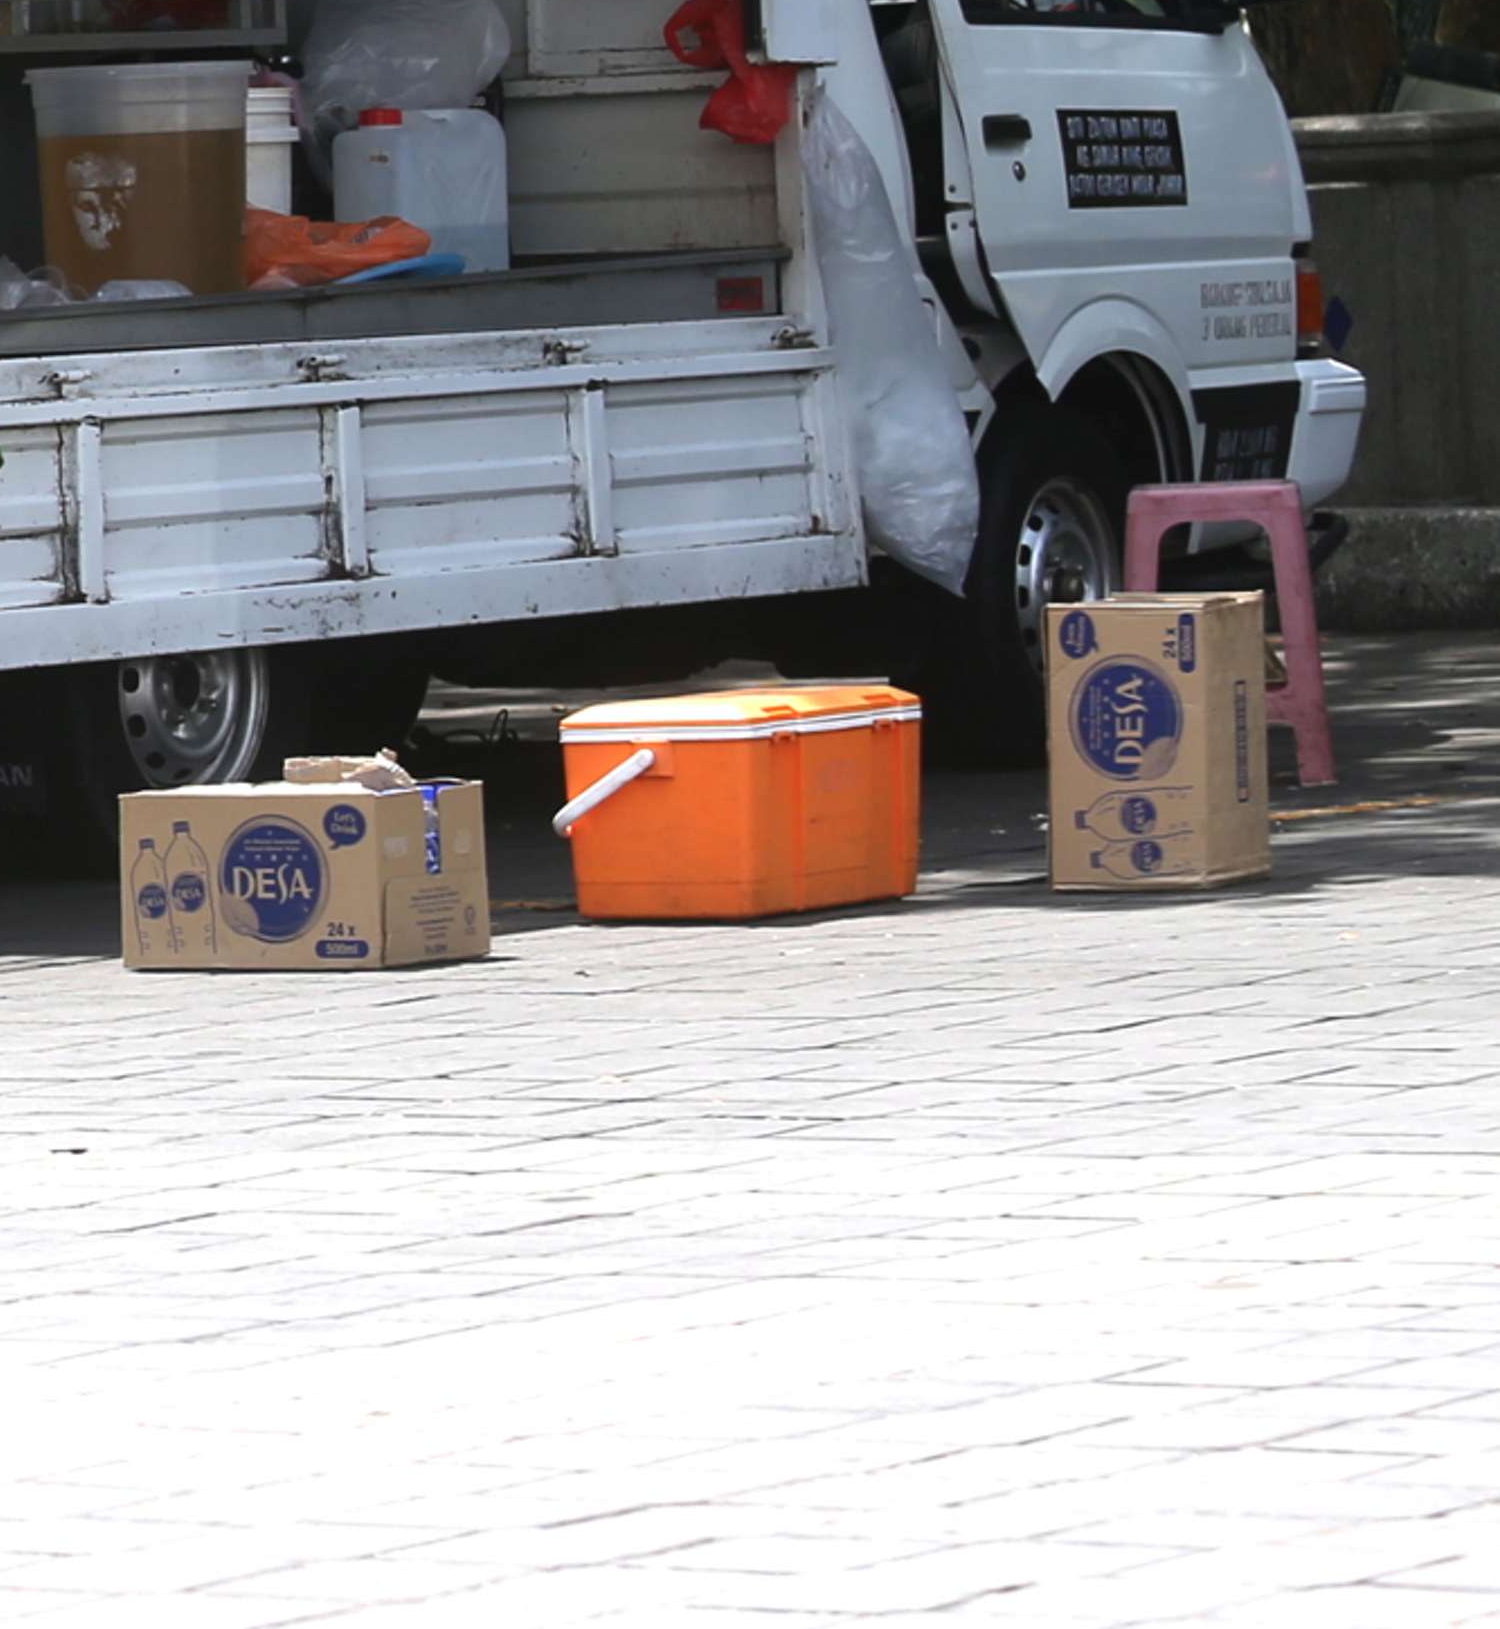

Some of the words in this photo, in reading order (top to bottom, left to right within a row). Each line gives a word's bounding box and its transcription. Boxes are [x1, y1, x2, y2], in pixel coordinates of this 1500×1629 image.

[1113, 673, 1148, 765] DESA
[233, 862, 312, 904] DESA
[327, 922, 344, 937] 24
[348, 925, 356, 937] x
